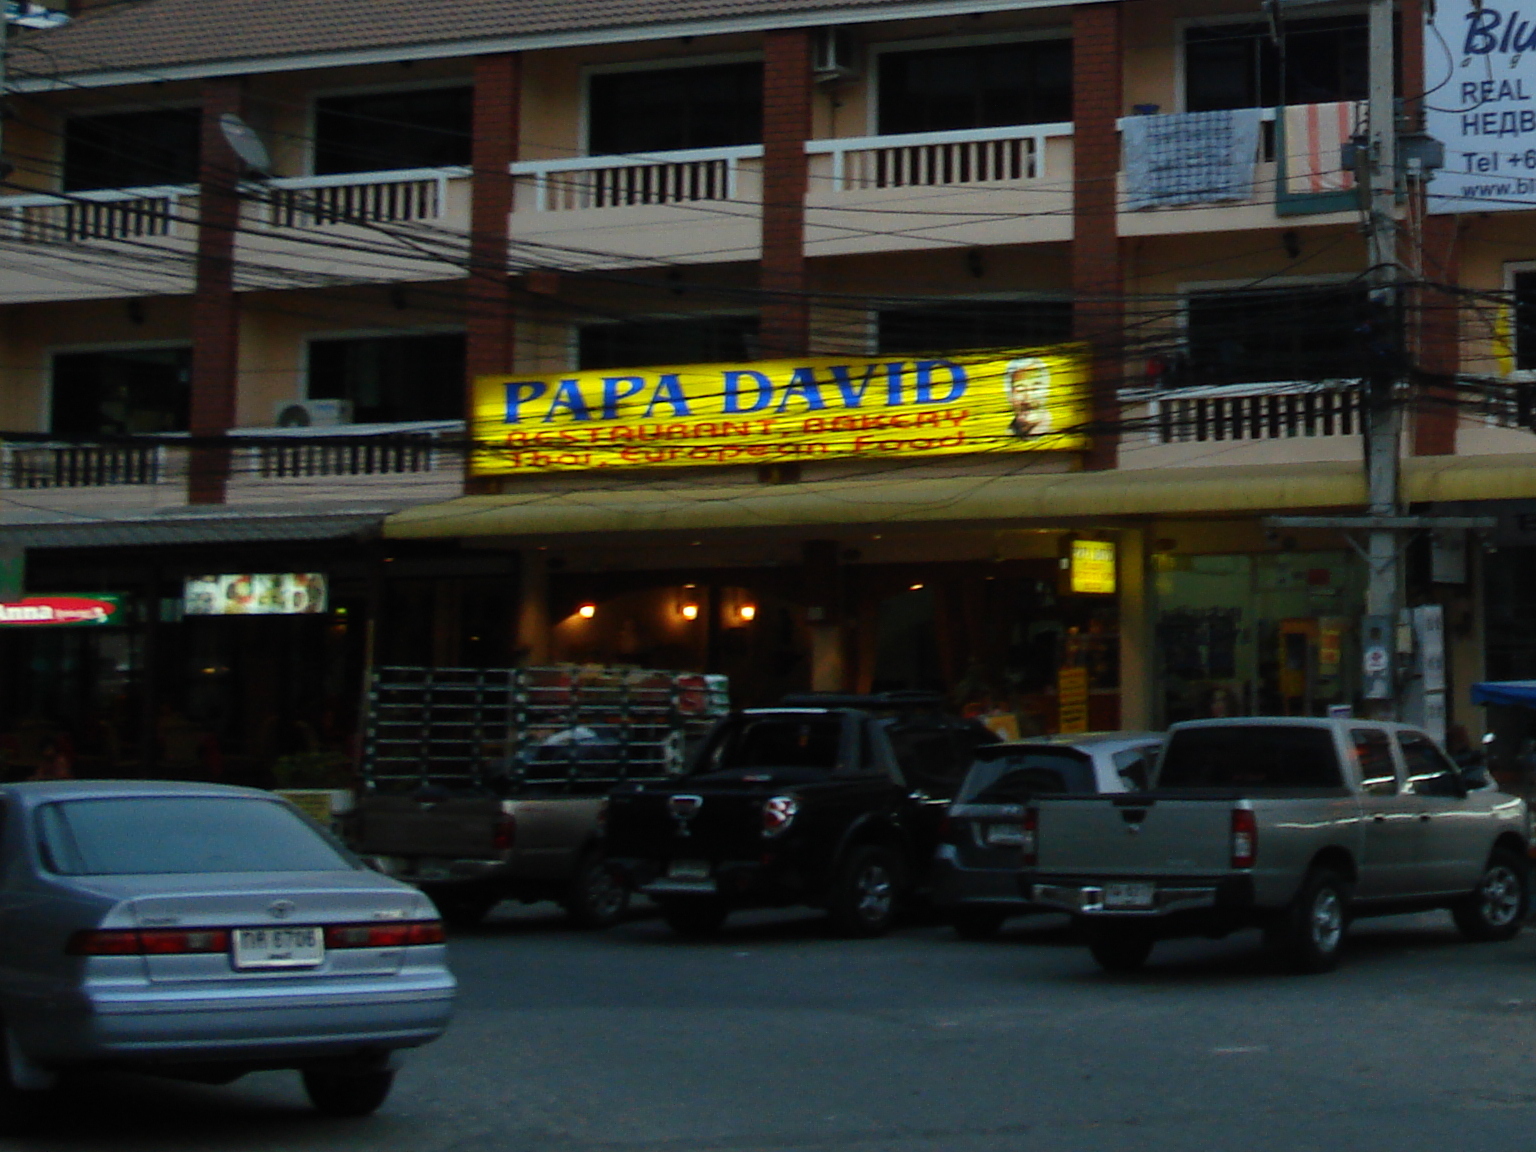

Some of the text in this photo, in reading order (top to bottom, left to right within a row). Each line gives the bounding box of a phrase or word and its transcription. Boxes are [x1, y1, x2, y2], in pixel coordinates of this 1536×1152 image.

[1462, 80, 1531, 103] REAL
[1462, 152, 1499, 174] Tel
[502, 359, 967, 424] PAPA DAVID
